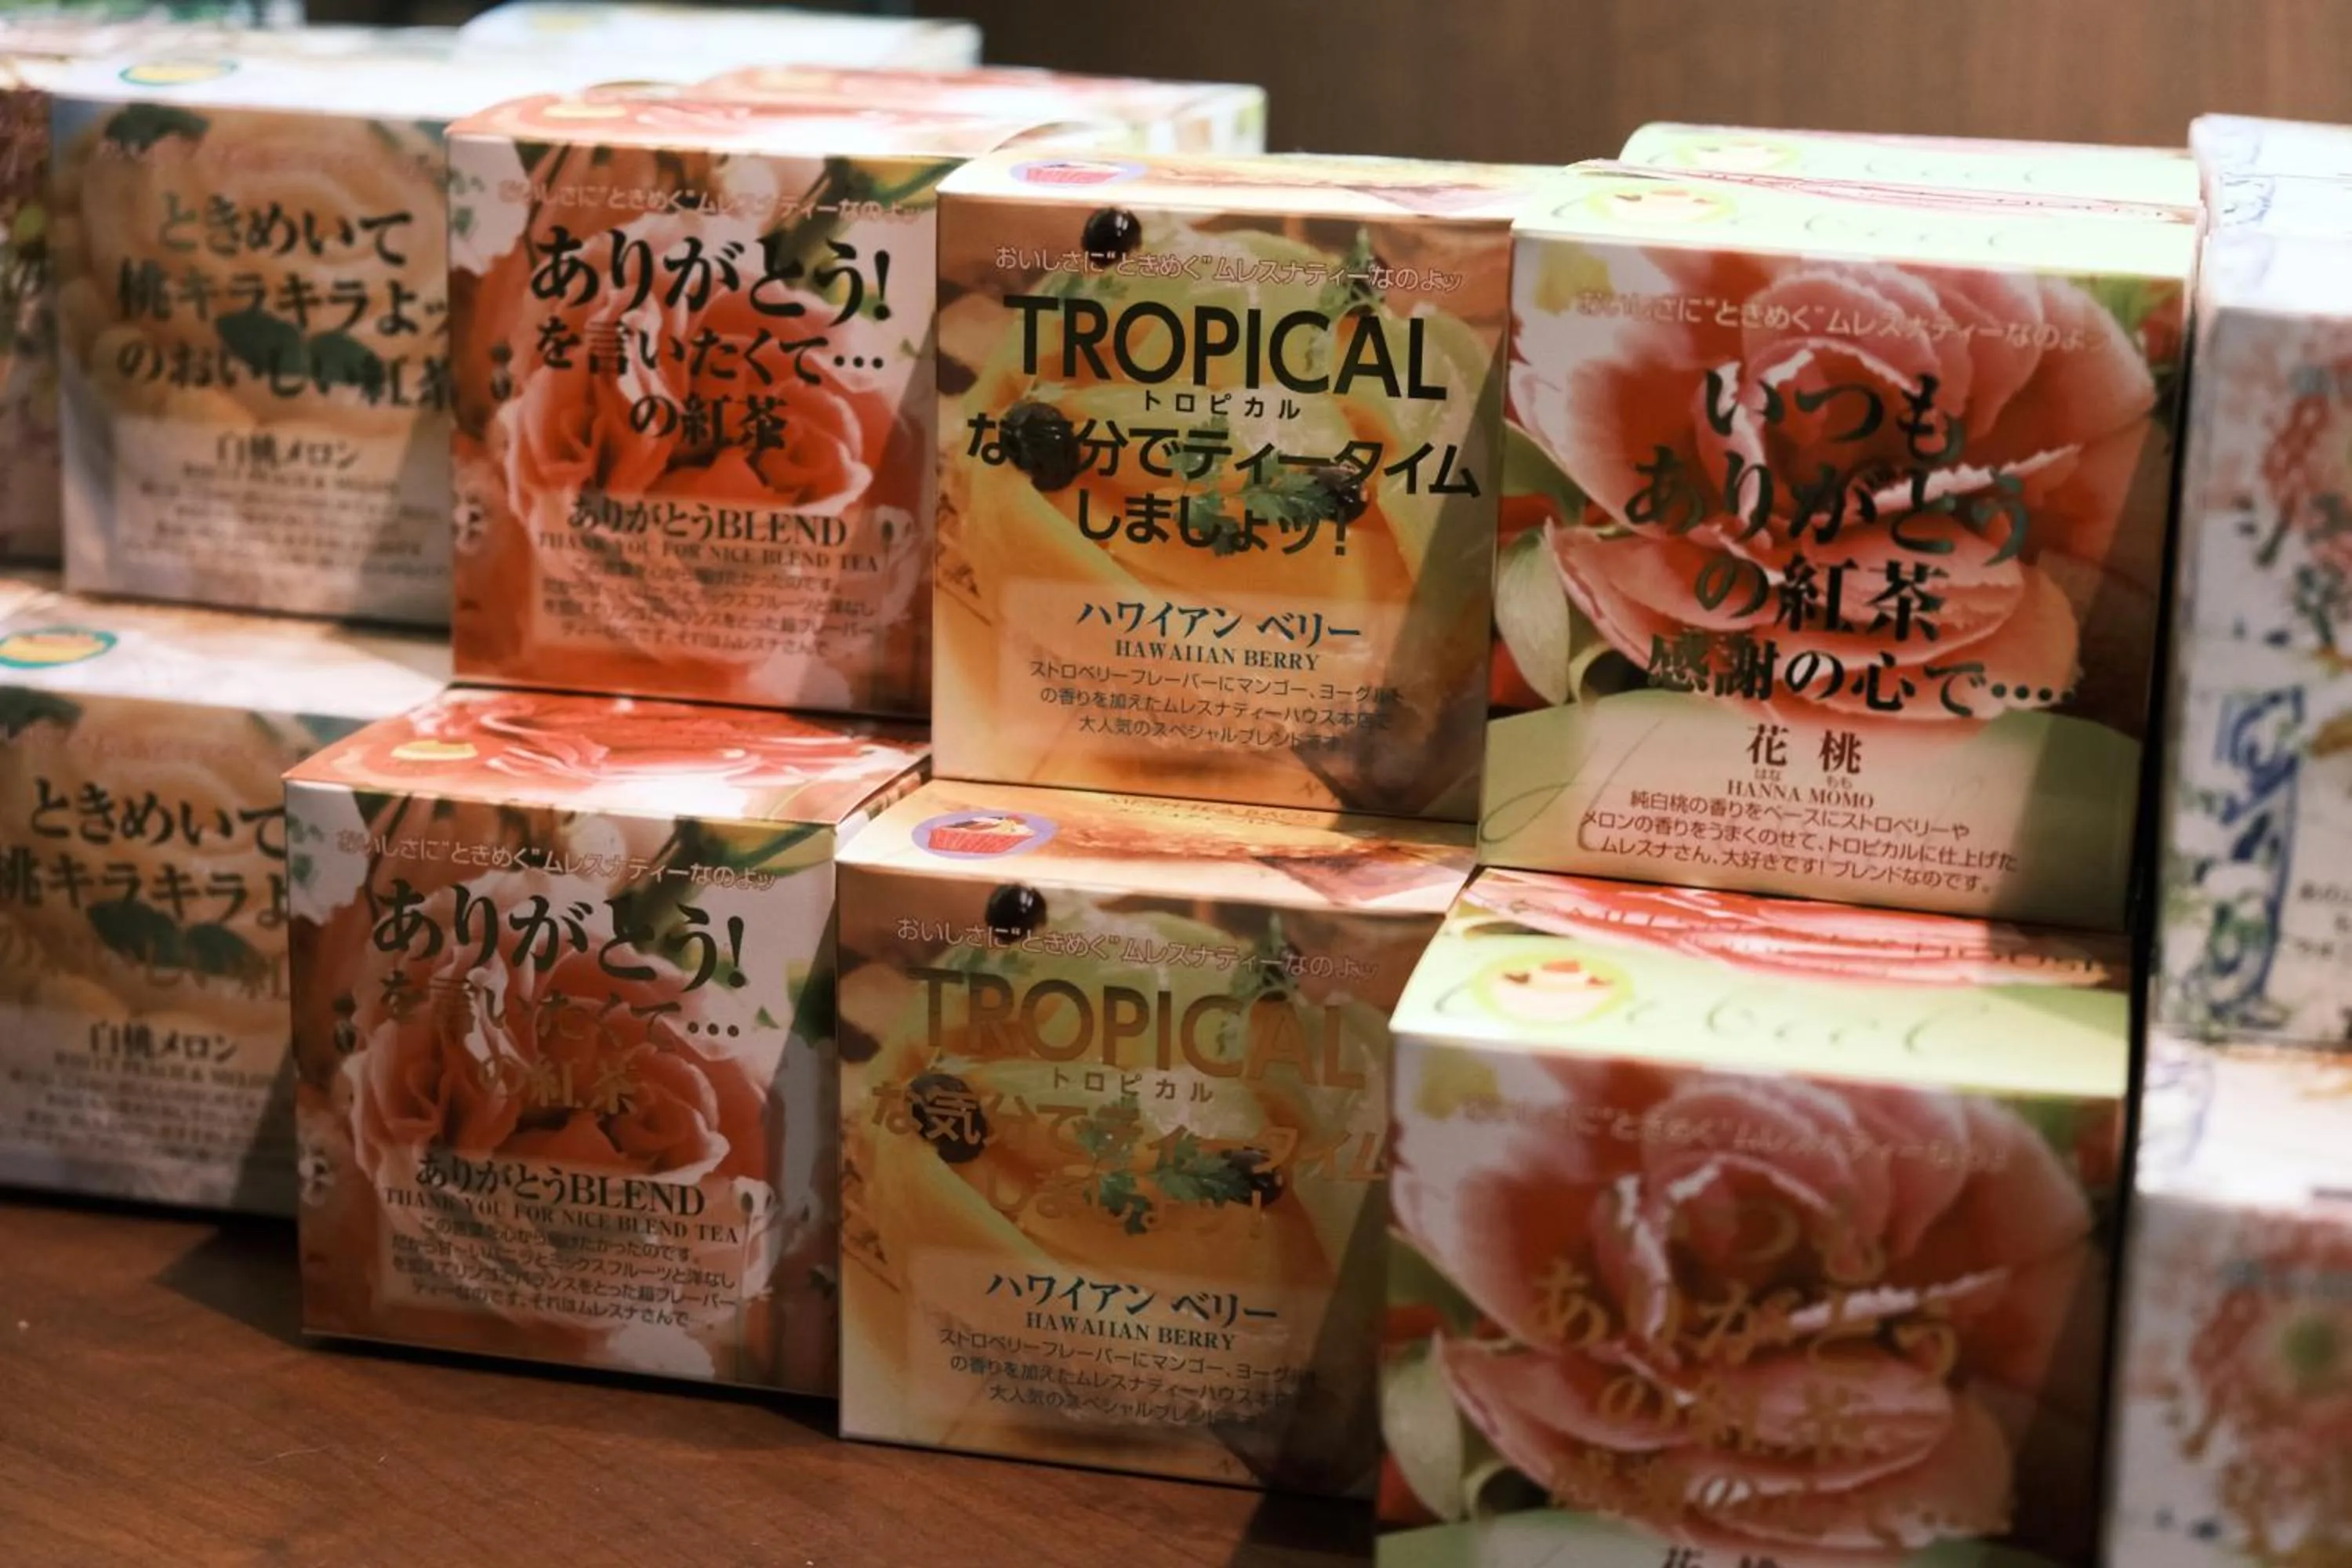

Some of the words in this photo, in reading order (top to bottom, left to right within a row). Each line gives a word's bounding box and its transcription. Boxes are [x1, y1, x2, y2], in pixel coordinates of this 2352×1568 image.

[161, 193, 413, 266] ときめいて
[530, 225, 891, 327] ありがとう!
[1003, 295, 1446, 401] TROPICAL
[630, 393, 788, 452] の紅茶
[1145, 390, 1301, 421] トロピカル
[1704, 368, 1965, 463] いつも
[967, 412, 1482, 498] な分でティータイム
[1624, 444, 2031, 566] ありがとう
[710, 545, 754, 563] NICE
[763, 550, 829, 568] BLEND
[840, 554, 878, 572] TEA
[1076, 601, 1243, 639] ハワイアン
[1258, 612, 1362, 648] ベリー
[1695, 552, 1951, 642] の紅茶
[1115, 638, 1237, 666] HAWAIIAN
[1243, 649, 1322, 672] BERRY
[30, 776, 288, 860] ときめいて
[1629, 789, 1970, 839] 純白桃の香りをベースにストロベリーや
[1727, 779, 1801, 802] HANNA
[1809, 788, 1875, 809] MOMO
[372, 878, 749, 992] ありがとう!
[906, 967, 1367, 1091] TROPICAL
[1052, 1065, 1214, 1105] トロピカル
[416, 1152, 706, 1217] ありがとうBLEND
[514, 1202, 554, 1225] FOR
[562, 1208, 613, 1230] NICE
[616, 1214, 688, 1238] BLEND
[697, 1224, 739, 1245] TEA
[985, 1273, 1156, 1316] ハワイアン
[1170, 1291, 1279, 1329] ベリー
[940, 1328, 1317, 1383] ストロベリーフレーバーにマンゴー、ヨーグ
[1026, 1310, 1150, 1341] HAWAIIAN
[1158, 1327, 1238, 1352] BERRY
